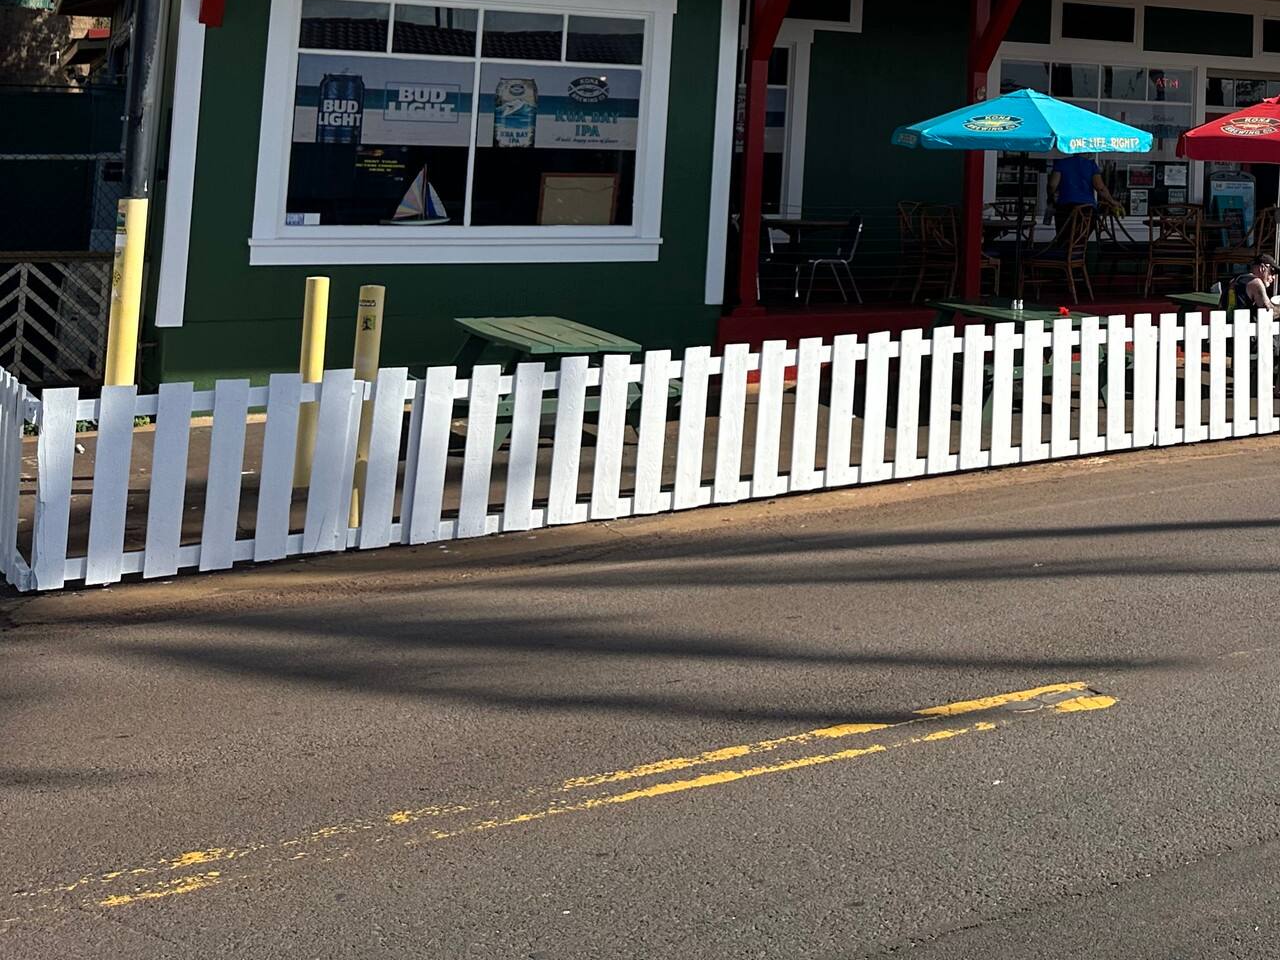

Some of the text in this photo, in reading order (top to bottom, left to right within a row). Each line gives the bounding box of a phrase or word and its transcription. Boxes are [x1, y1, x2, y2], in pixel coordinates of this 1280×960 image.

[1155, 77, 1180, 89] ATM
[398, 86, 447, 103] BUD
[323, 99, 359, 113] BUD
[388, 101, 455, 119] LIGHT
[318, 112, 362, 127] LIGHT
[575, 124, 601, 137] IPA
[1070, 137, 1087, 149] ONE
[1111, 137, 1140, 150] RIGHT?
